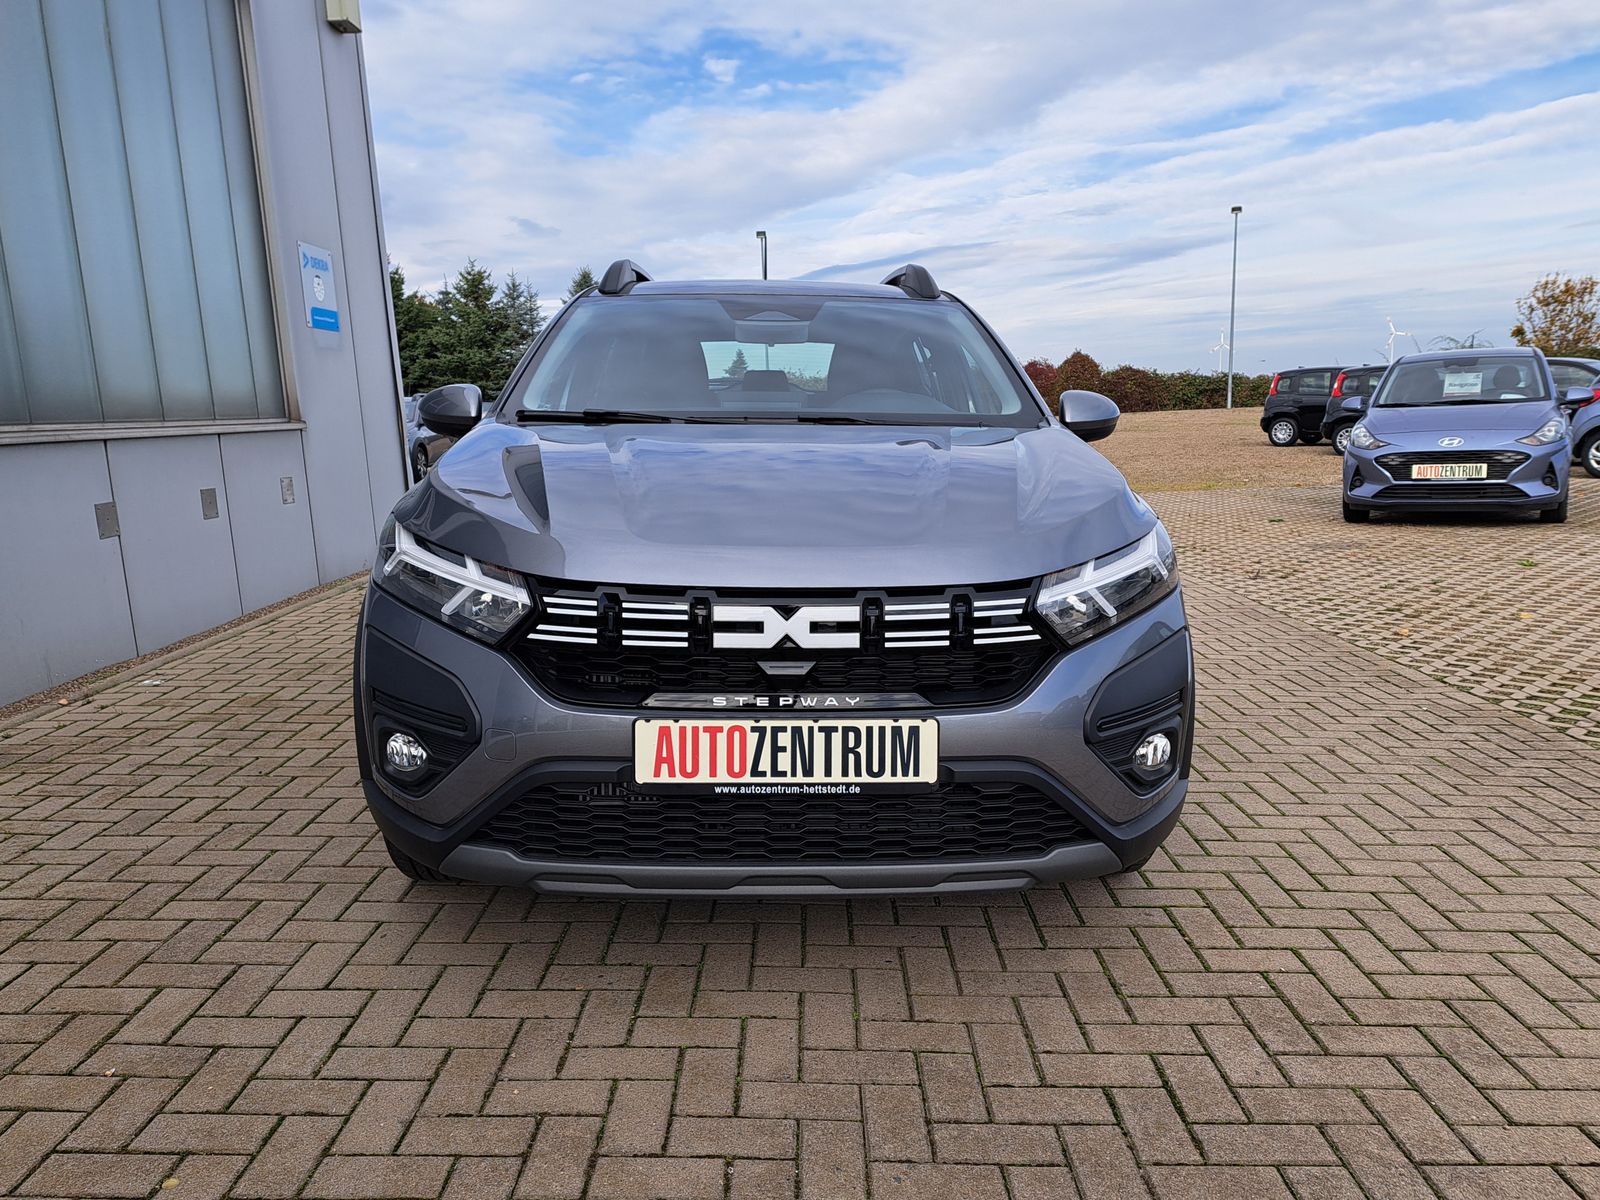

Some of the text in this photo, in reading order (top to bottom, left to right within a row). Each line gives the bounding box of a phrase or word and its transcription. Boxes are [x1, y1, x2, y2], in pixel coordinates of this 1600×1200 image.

[1416, 465, 1483, 478] AUTOZENTRUM
[712, 697, 861, 706] STEPWAY
[653, 725, 920, 778] AUTOZENTRUM
[714, 785, 861, 794] www.autozentrum-hettstedt.de
